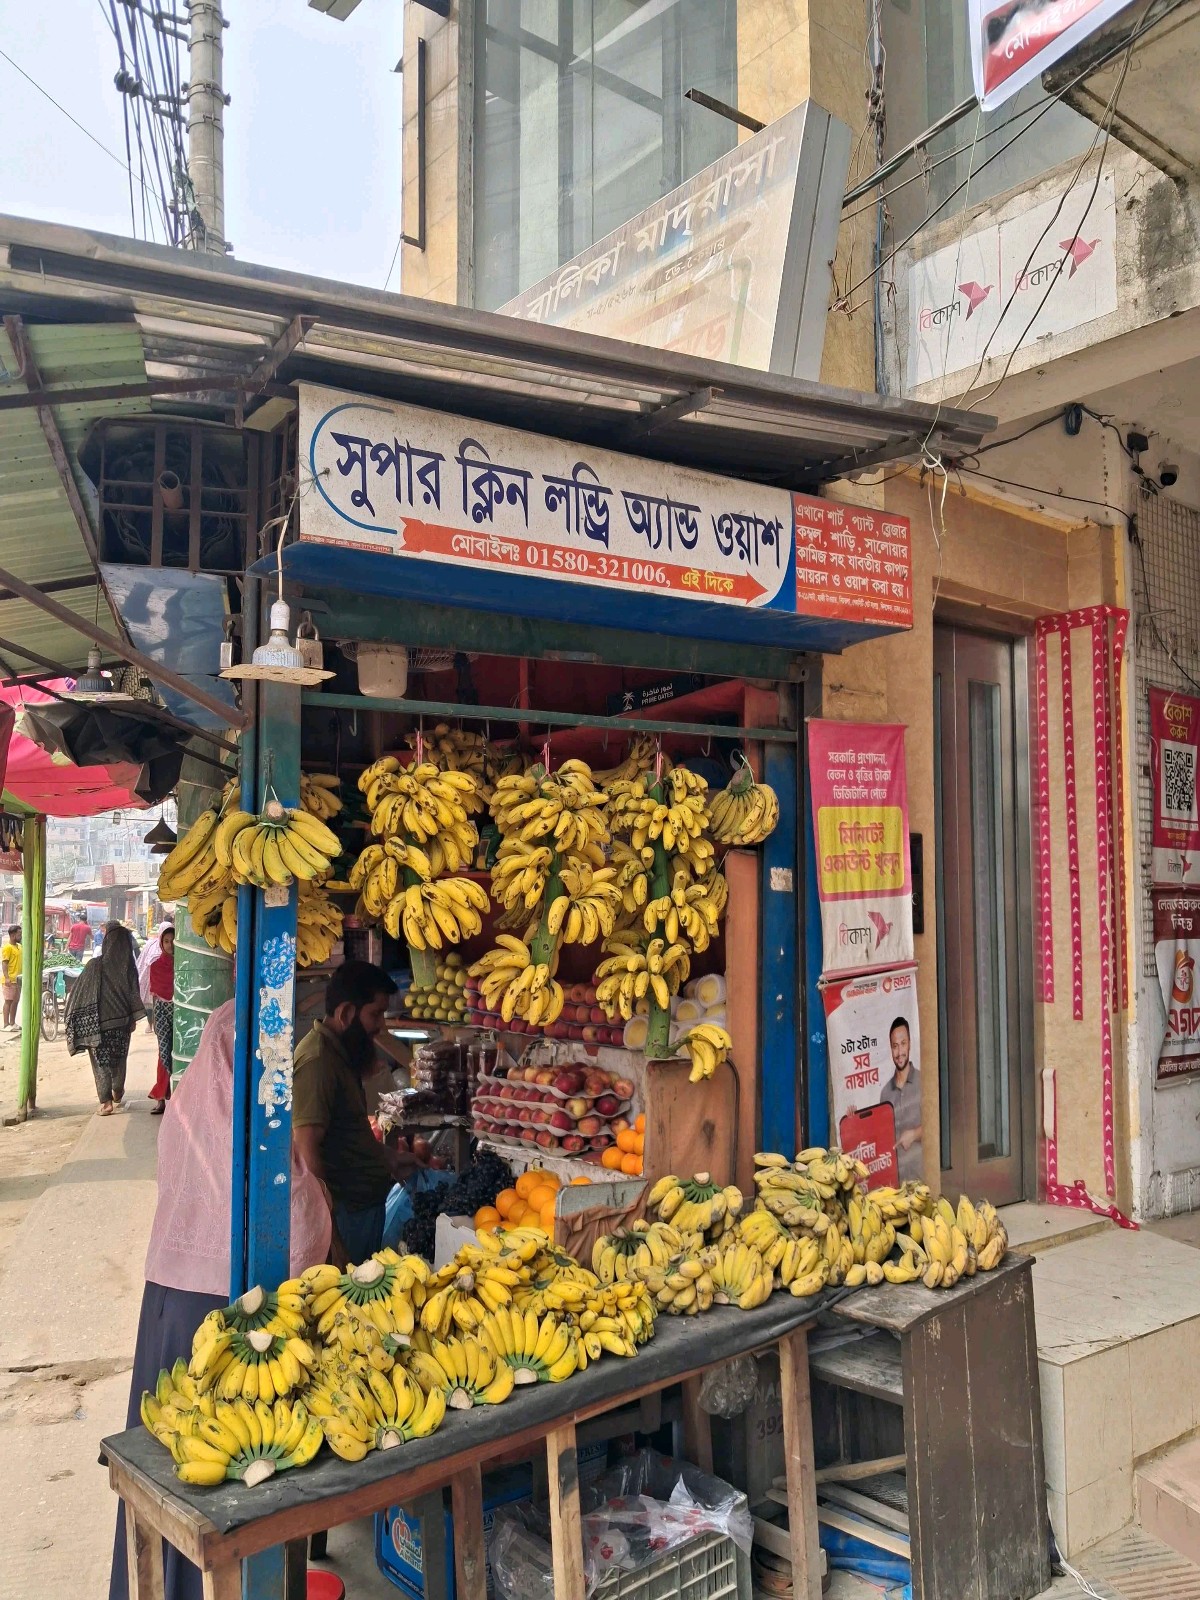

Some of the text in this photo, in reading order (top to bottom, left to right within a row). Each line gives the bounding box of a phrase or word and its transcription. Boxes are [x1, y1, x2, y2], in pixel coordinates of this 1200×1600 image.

[1015, 257, 1064, 294] বিকাশ
[919, 300, 961, 331] বিকাশ
[330, 431, 784, 569] সুপার ক্লিন লন্ড্রি অ্যান্ড ওয়াশ
[795, 504, 825, 524] এখানে
[795, 543, 828, 565] কামিজ
[828, 552, 846, 570] সহ
[846, 552, 882, 574] যাবতীয়
[864, 537, 908, 560] সালোয়ার
[451, 533, 735, 592] মোবাইলঃ 01580-321006, এই দিকে
[795, 566, 829, 586] আয়রন
[831, 574, 841, 587] ও
[844, 575, 869, 592] ওয়াশ
[870, 579, 889, 596] করা
[641, 695, 658, 706] PRIME
[1169, 723, 1189, 741] করুন
[827, 749, 888, 766] সরকারি প্রণোদনা,
[826, 768, 891, 783] বেতন ও বৃত্তির টাকা
[833, 784, 887, 800] ডিজিটালি পেতে
[838, 821, 885, 845] মিনিটেই
[823, 848, 900, 877] একাউন্ট খুলুন
[838, 921, 872, 946] বিকাশ
[840, 1039, 855, 1054] ১টা
[856, 1034, 871, 1051] ২টা
[852, 1052, 871, 1070] সব
[844, 1067, 880, 1091] নাম্বারে
